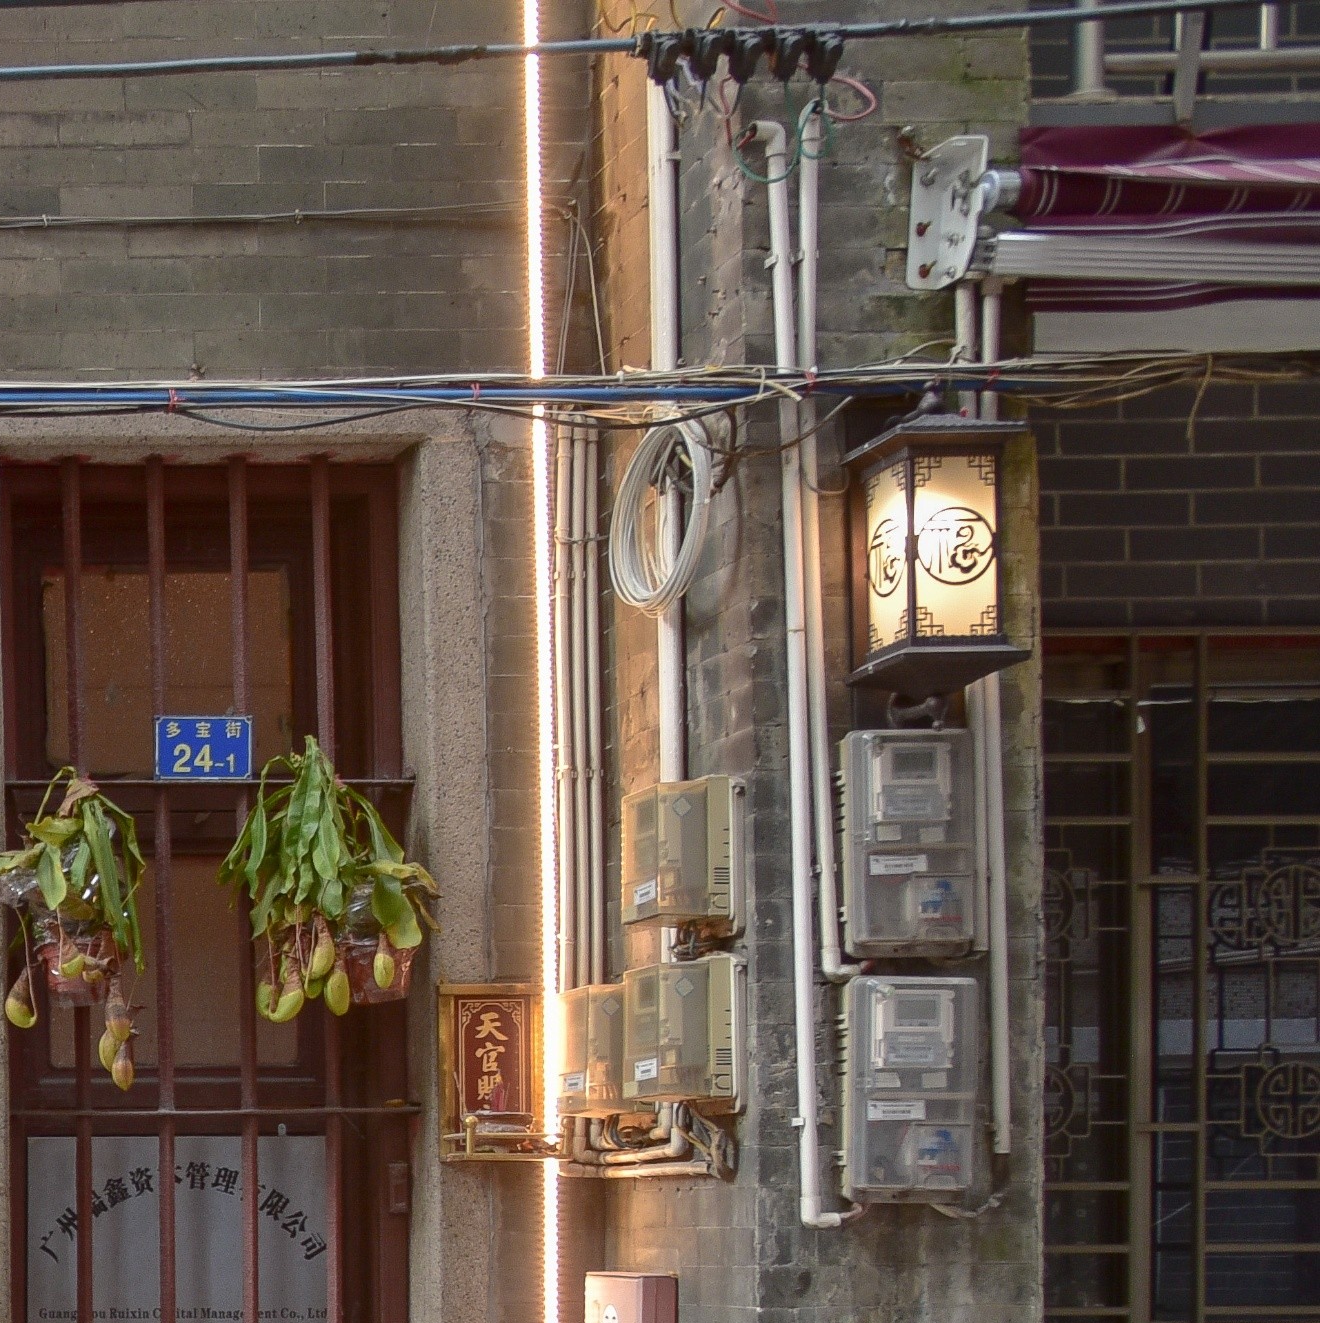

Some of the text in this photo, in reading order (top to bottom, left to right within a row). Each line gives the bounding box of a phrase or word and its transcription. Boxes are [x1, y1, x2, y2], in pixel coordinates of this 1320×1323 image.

[165, 721, 242, 739] 多宝街
[172, 743, 236, 774] 24-1
[475, 1012, 509, 1110] 天官賜
[39, 1307, 106, 1320] Guangou
[109, 1307, 150, 1319] Ruixin
[152, 1307, 197, 1319] Cital
[200, 1307, 278, 1320] Manageent
